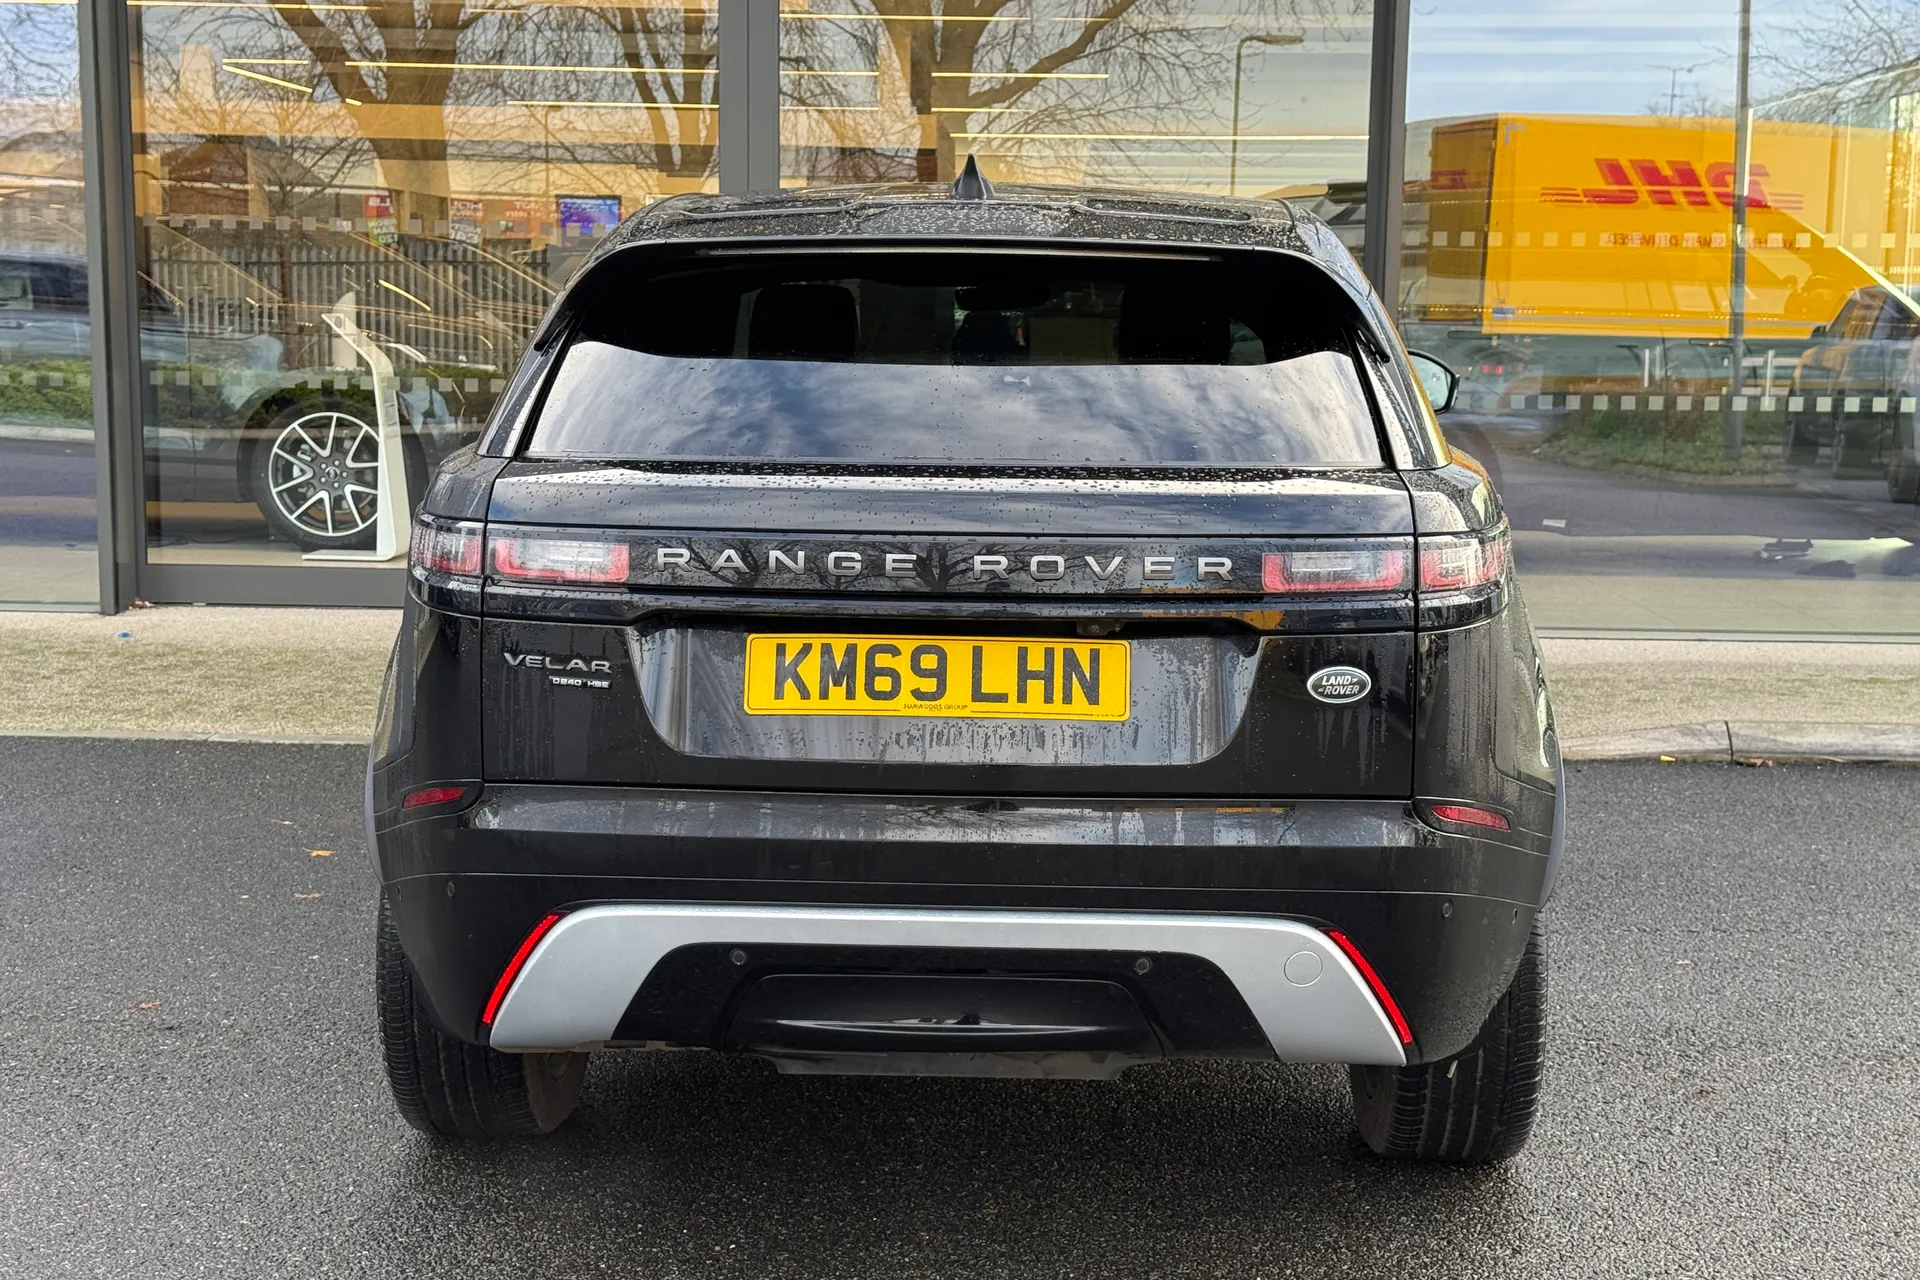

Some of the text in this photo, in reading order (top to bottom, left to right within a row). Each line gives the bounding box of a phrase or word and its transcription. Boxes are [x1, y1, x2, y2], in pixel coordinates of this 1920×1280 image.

[656, 547, 1234, 581] RANGE ROVER
[503, 652, 613, 674] VELAR
[773, 642, 1101, 706] KM69 LHN
[1321, 675, 1352, 686] LAND
[1323, 684, 1360, 695] ROVER
